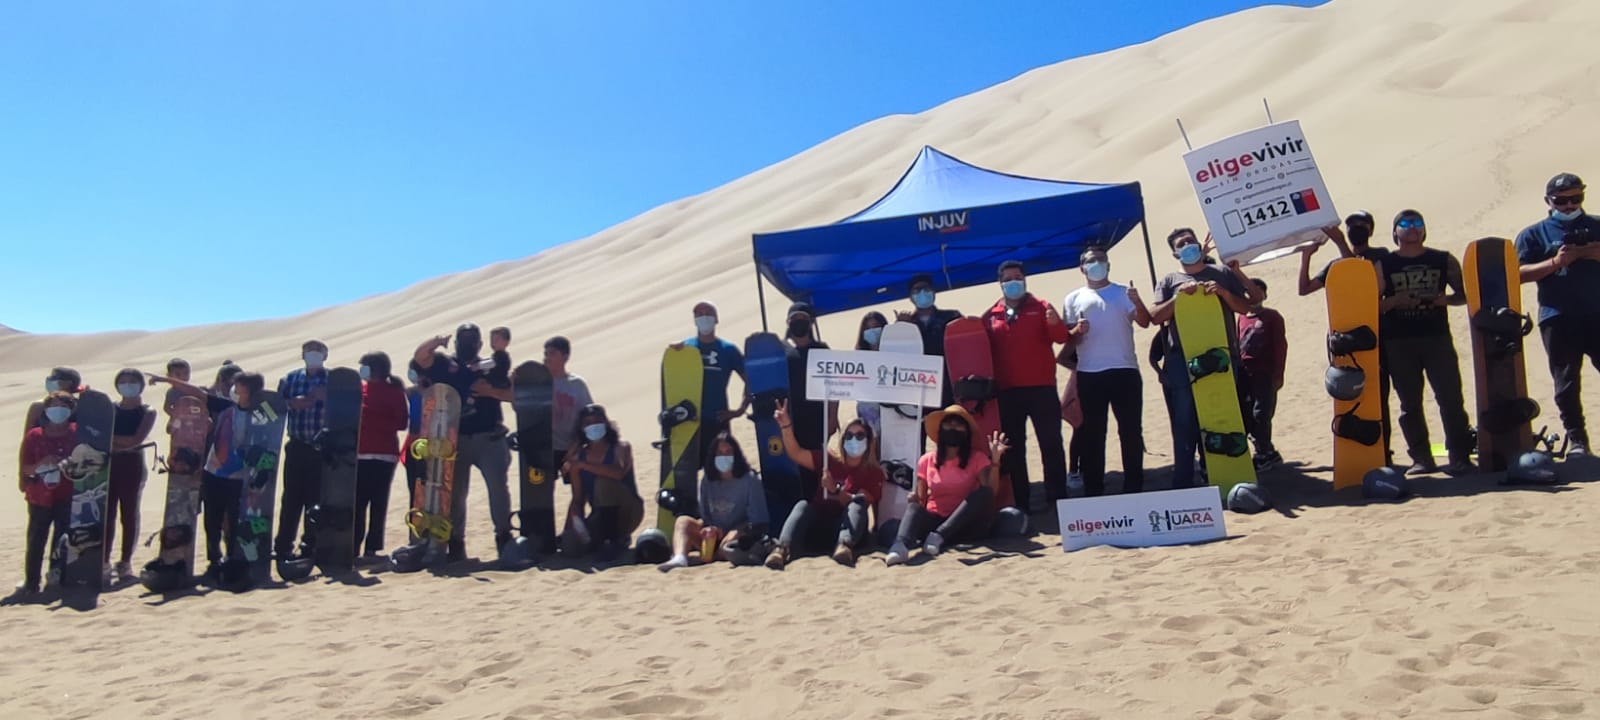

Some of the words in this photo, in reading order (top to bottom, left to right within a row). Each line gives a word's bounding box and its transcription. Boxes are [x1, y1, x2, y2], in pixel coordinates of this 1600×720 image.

[1195, 136, 1303, 183] eligevivir
[1246, 160, 1293, 178] DROGAS
[918, 211, 966, 231] INJUV
[1243, 200, 1291, 226] 1412
[816, 361, 865, 375] SENDA
[1067, 515, 1135, 534] eligevivir
